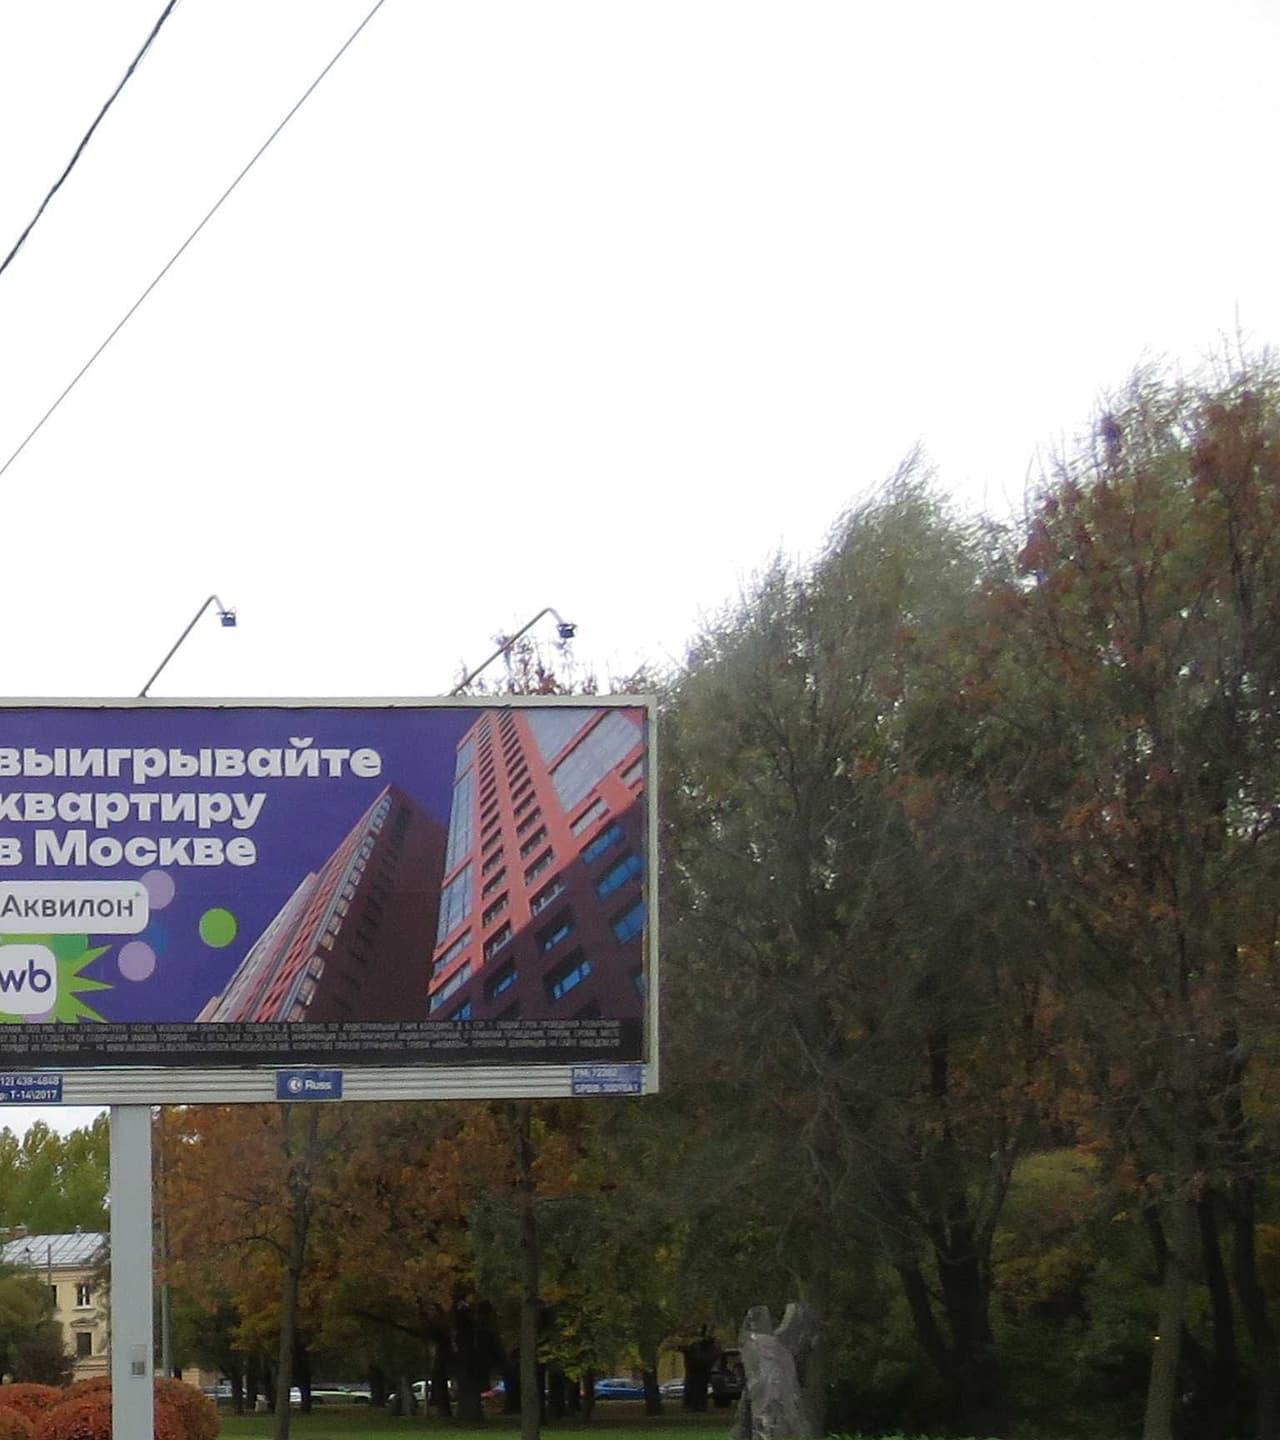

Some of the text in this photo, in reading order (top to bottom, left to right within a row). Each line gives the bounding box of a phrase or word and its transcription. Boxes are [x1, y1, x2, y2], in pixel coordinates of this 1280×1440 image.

[35, 829, 257, 867] Москве
[0, 894, 134, 918] Аквилон
[304, 1079, 333, 1090] Russ
